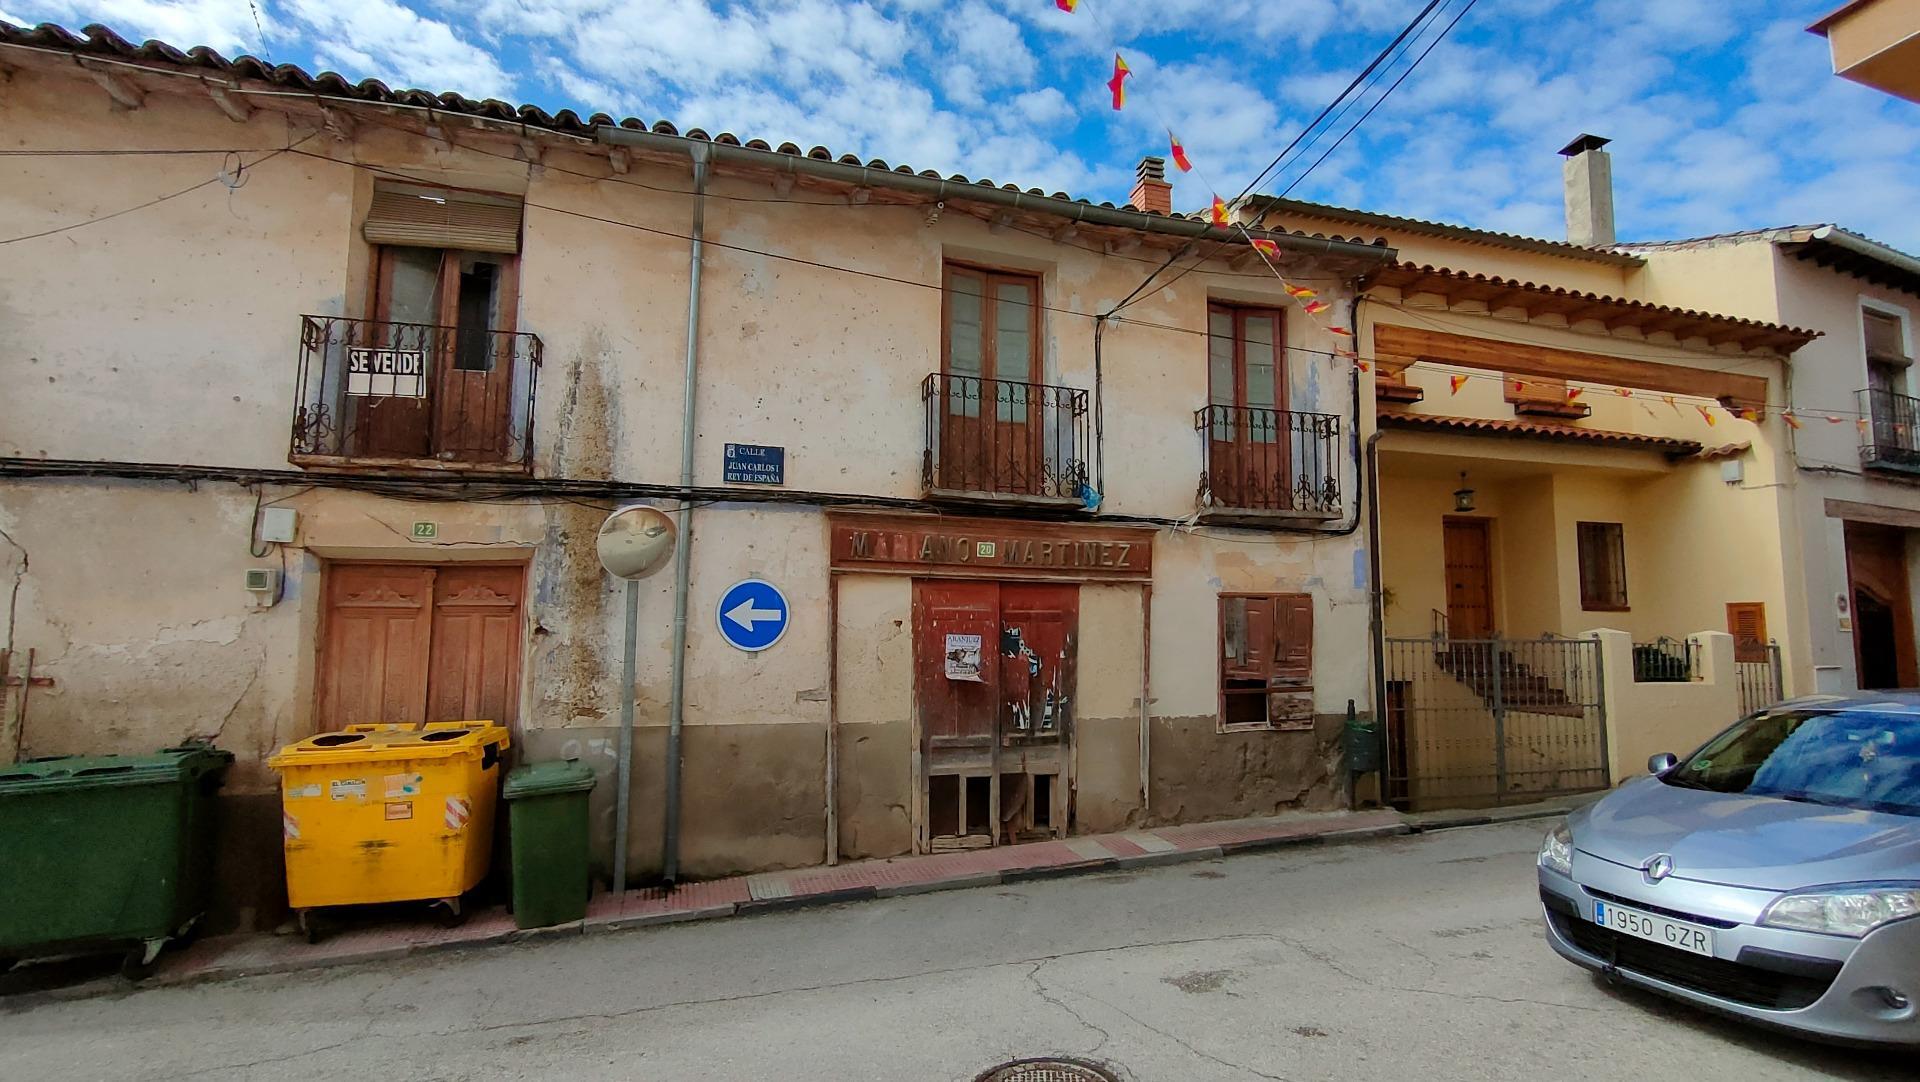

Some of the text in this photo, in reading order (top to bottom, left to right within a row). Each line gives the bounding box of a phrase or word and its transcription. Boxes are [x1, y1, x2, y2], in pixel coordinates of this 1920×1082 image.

[350, 351, 421, 374] SE VENDE
[739, 447, 765, 456] CALLE
[728, 461, 747, 471] JUAN
[747, 463, 774, 472] CARLOS
[727, 472, 780, 483] REY DE ESPAÑA
[417, 524, 433, 535] 22
[980, 544, 992, 555] 20
[1003, 539, 1131, 567] MARTINEZ
[1607, 908, 1706, 952] 1950 GZR
